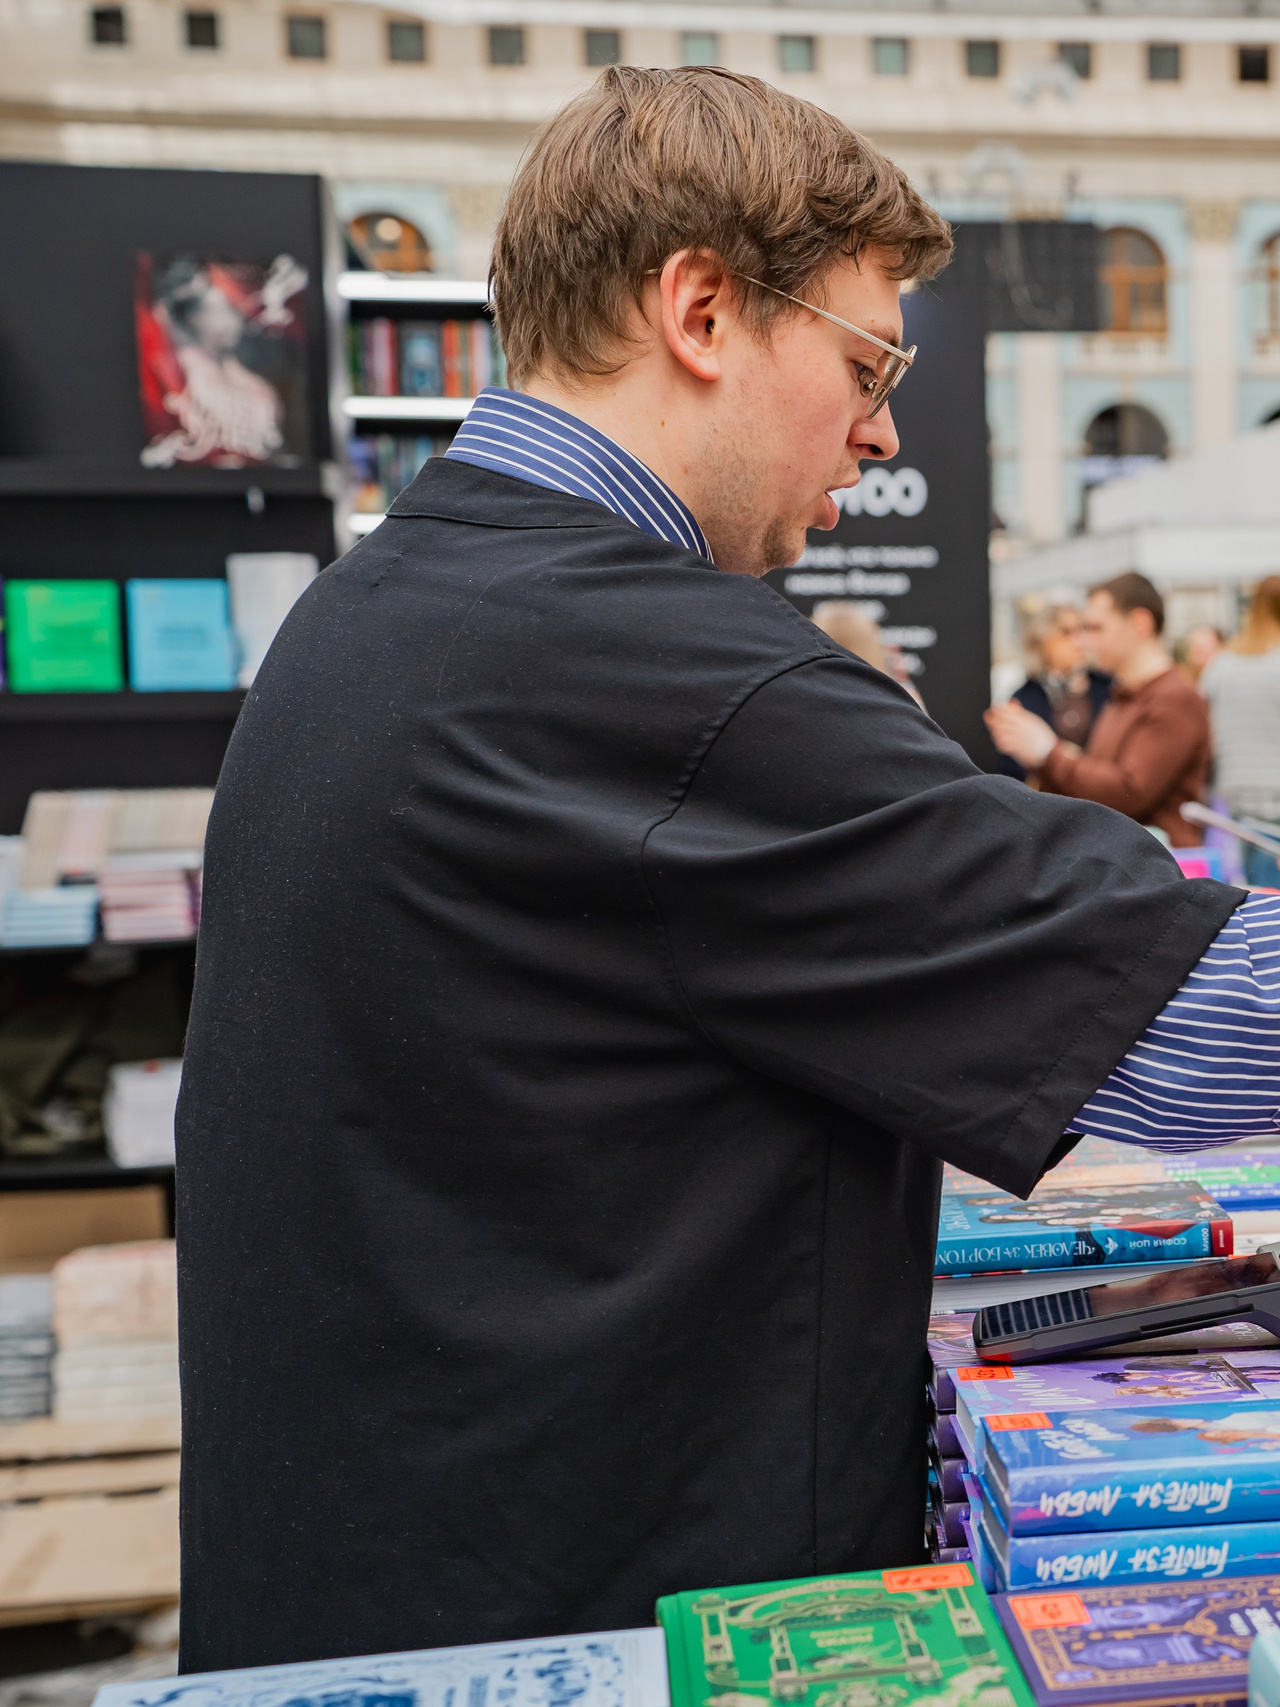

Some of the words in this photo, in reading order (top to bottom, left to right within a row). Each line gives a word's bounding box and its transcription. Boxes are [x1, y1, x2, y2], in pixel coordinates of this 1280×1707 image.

[1129, 1239, 1151, 1249] ЦОЙ
[1153, 1237, 1188, 1247] СОФИЯ
[1003, 1247, 1021, 1259] ЗА
[1024, 1240, 1096, 1262] ЧЕЛОВЕК
